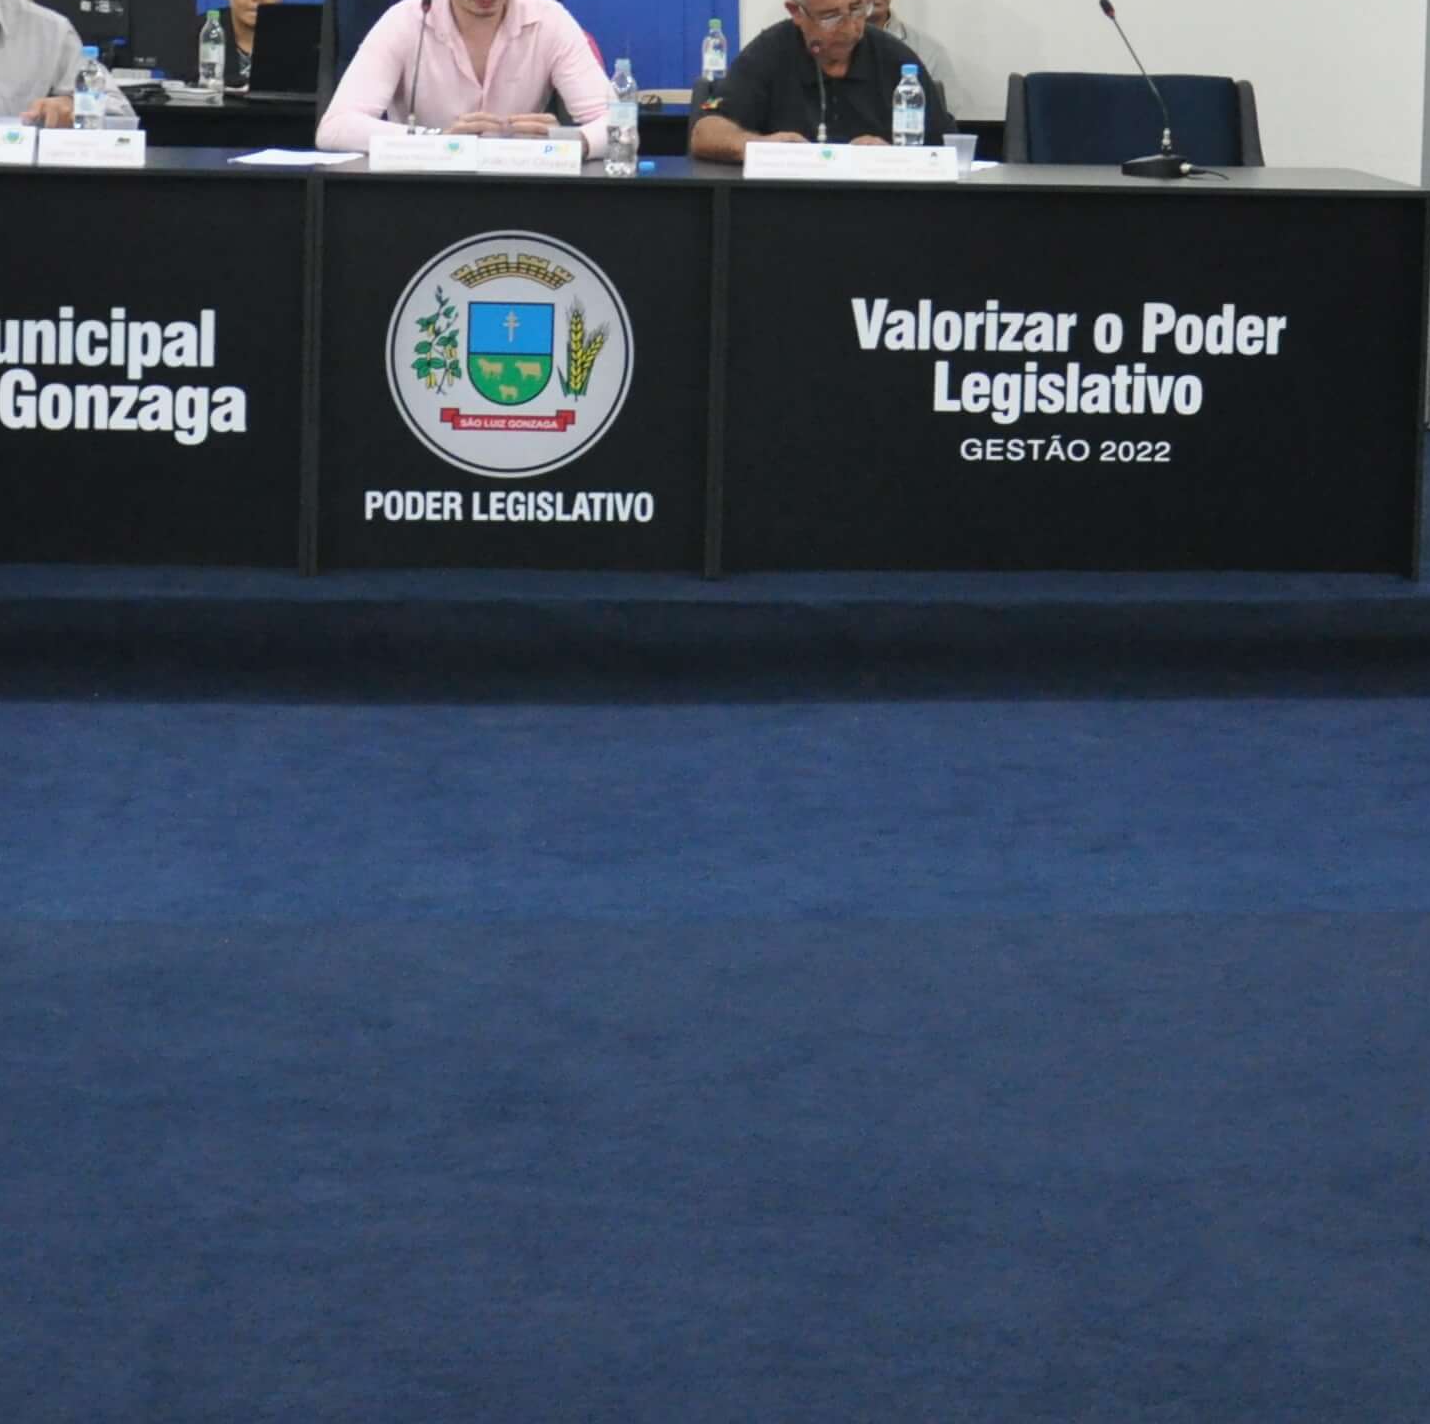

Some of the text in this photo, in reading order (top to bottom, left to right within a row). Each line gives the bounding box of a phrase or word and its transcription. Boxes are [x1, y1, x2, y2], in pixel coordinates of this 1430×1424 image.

[851, 297, 1287, 356] Valorizar o Poder
[933, 360, 1203, 425] Legislativo
[459, 416, 558, 429] SÃO LUIZ GONZAGA
[960, 434, 1171, 463] GESTÃO 2022
[364, 490, 654, 523] PODER LEGISLATIVO
